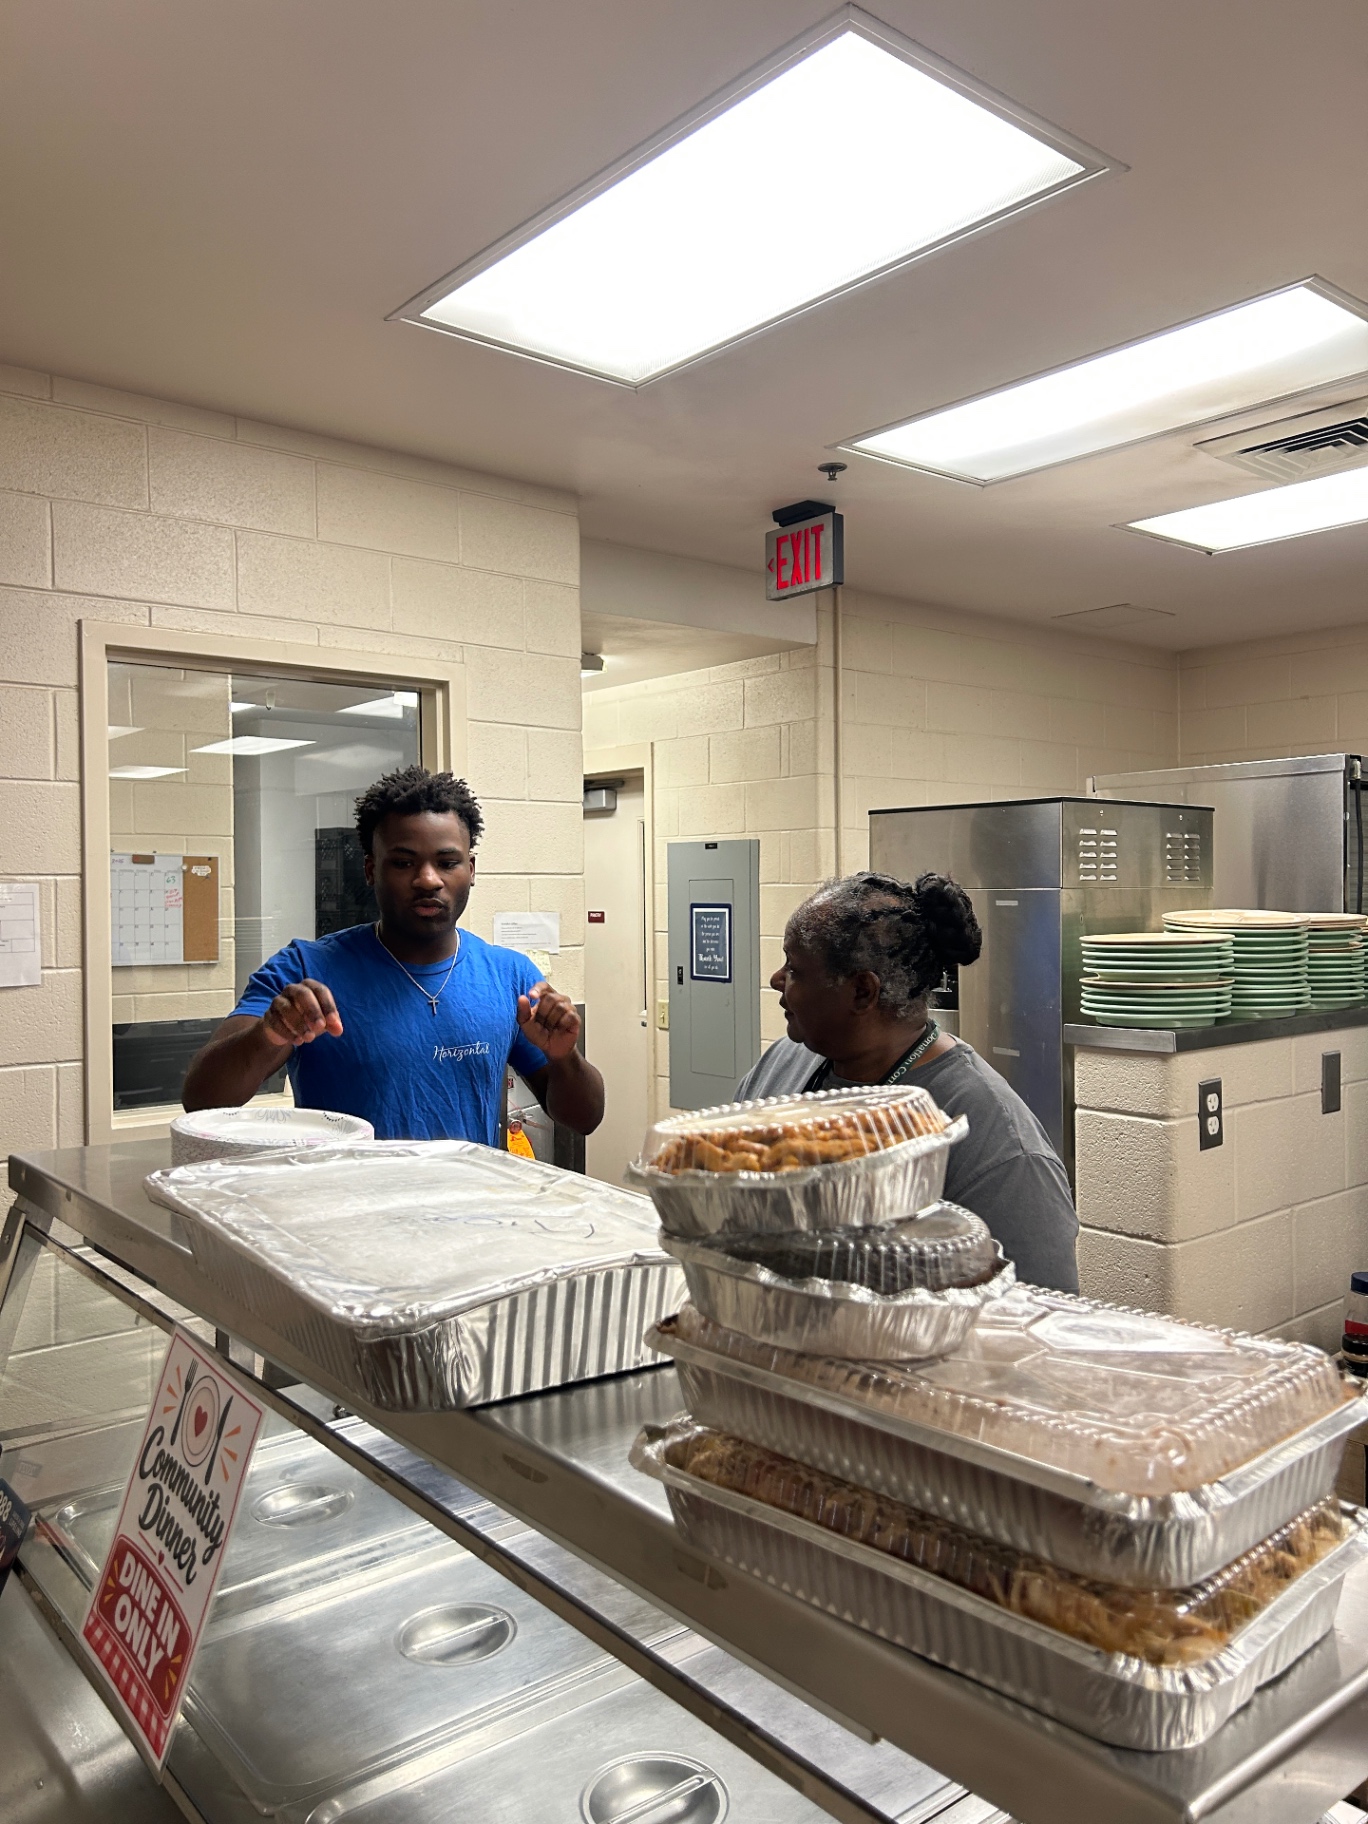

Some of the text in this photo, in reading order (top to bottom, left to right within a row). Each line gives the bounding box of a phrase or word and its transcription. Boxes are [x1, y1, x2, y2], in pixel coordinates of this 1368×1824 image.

[776, 524, 824, 591] EXIT
[433, 1041, 489, 1062] Horizontal
[887, 1066, 907, 1086] Con
[138, 1483, 197, 1585] Dinner
[139, 1425, 225, 1565] Community
[114, 1593, 165, 1680] ONLY
[119, 1551, 181, 1659] DINE IN
